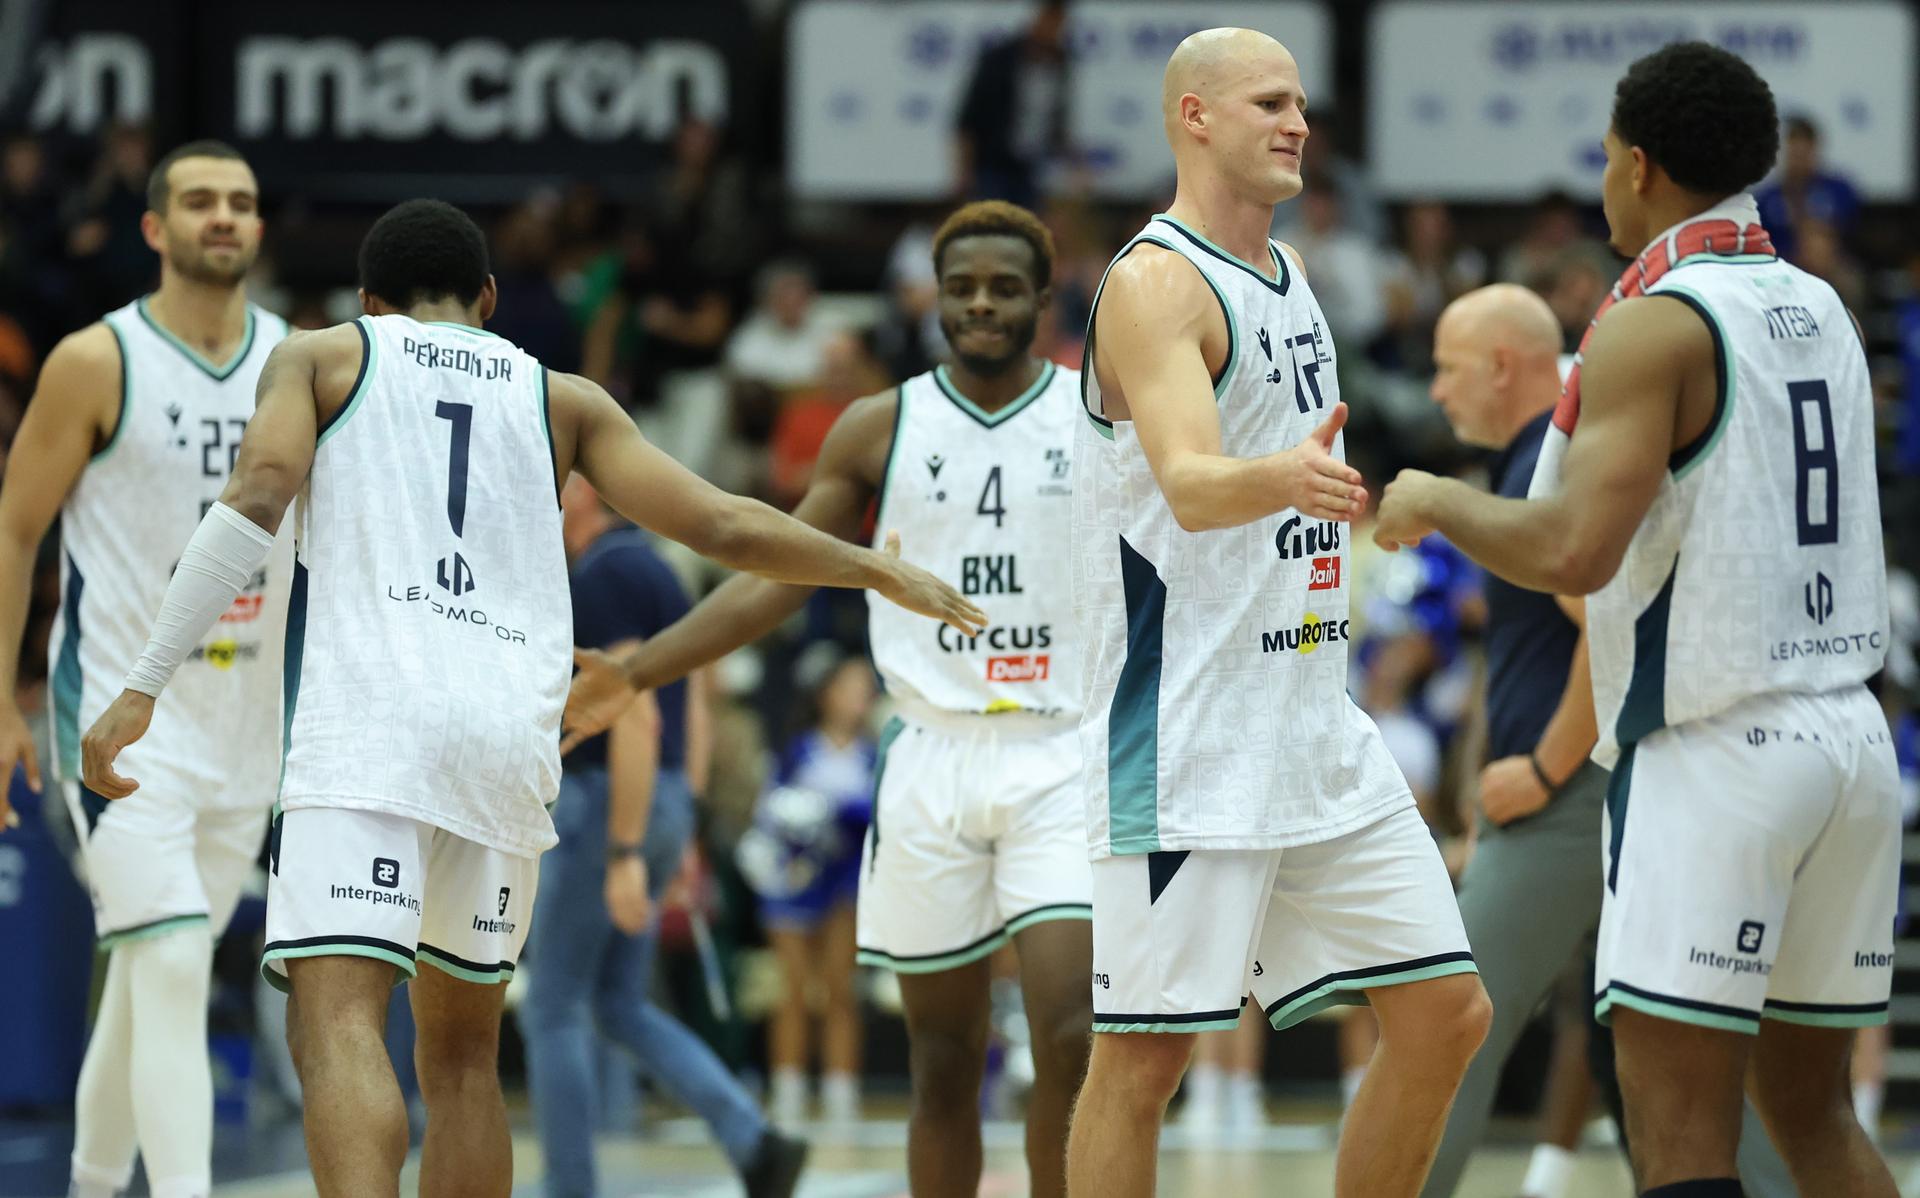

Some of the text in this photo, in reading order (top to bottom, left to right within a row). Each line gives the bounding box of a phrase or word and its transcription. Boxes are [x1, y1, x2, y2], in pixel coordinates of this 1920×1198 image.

[236, 37, 728, 141] macron
[404, 337, 511, 382] PERSON JR
[435, 400, 473, 538] 1
[977, 465, 1006, 527] 4
[1787, 379, 1838, 546] 8
[963, 555, 1023, 595] BXL
